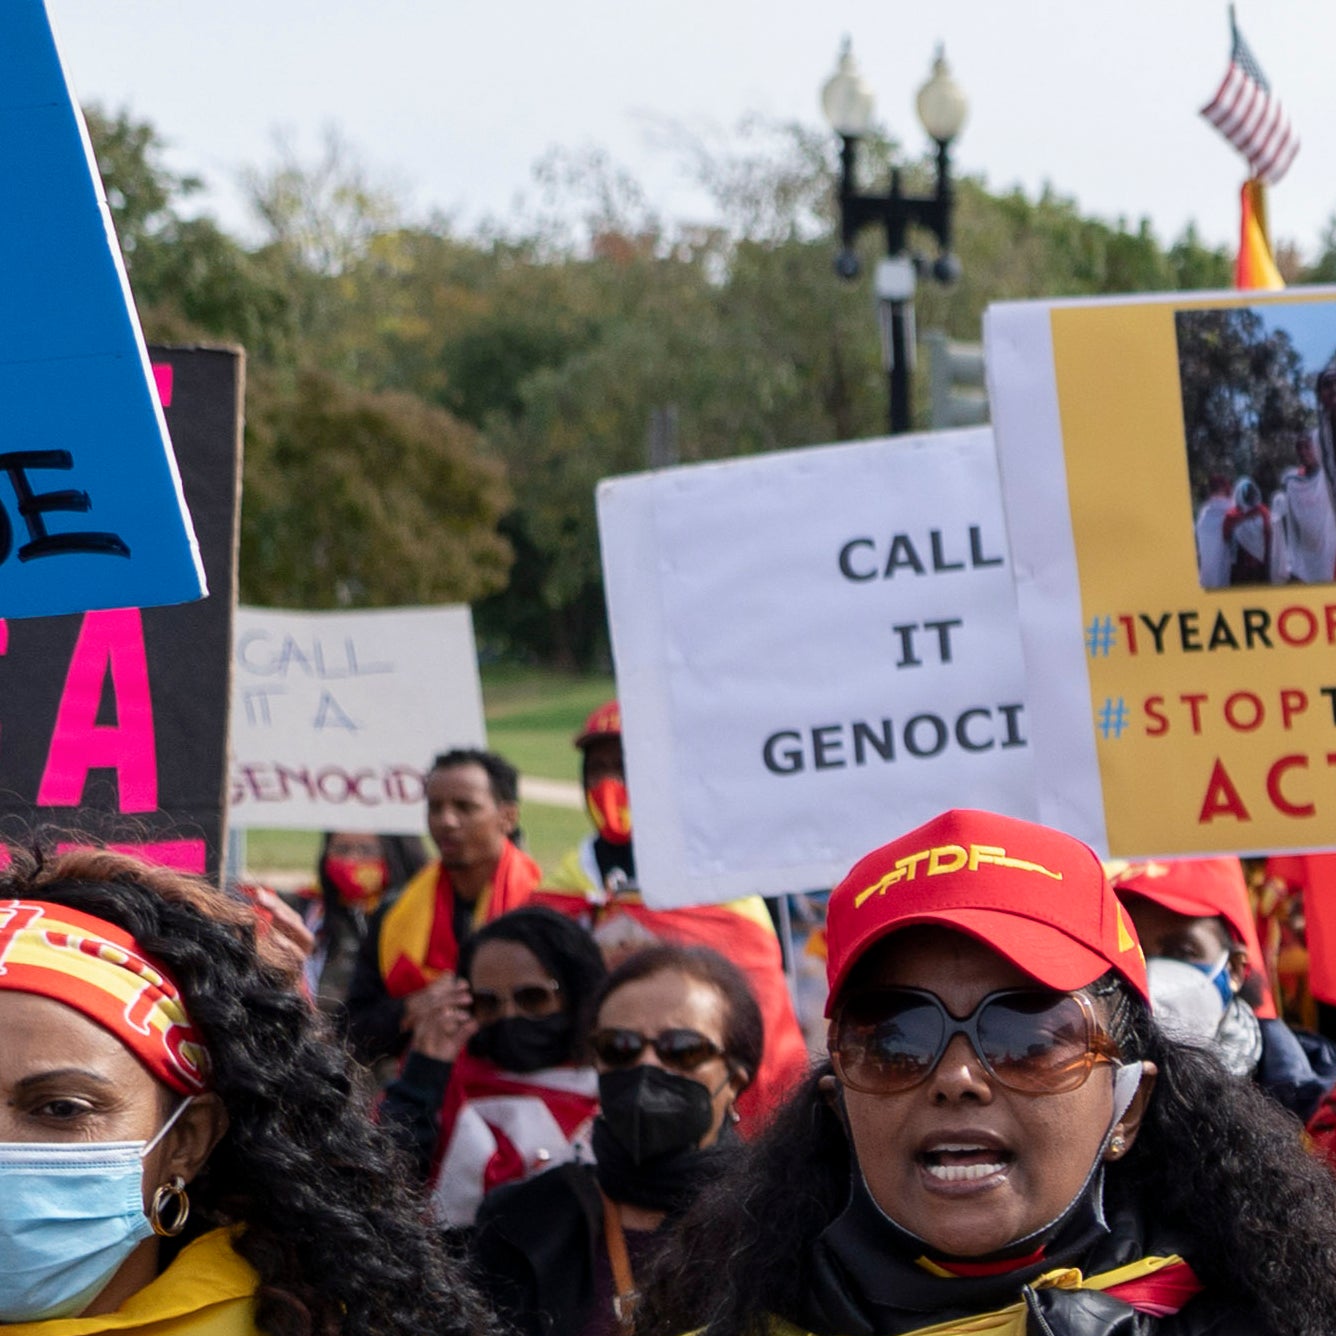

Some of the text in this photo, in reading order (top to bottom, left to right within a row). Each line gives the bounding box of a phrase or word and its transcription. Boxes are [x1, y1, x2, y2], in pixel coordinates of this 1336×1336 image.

[838, 525, 1004, 583] CALL
[237, 629, 395, 680] CALL
[893, 619, 963, 669] IT
[312, 689, 361, 731] A
